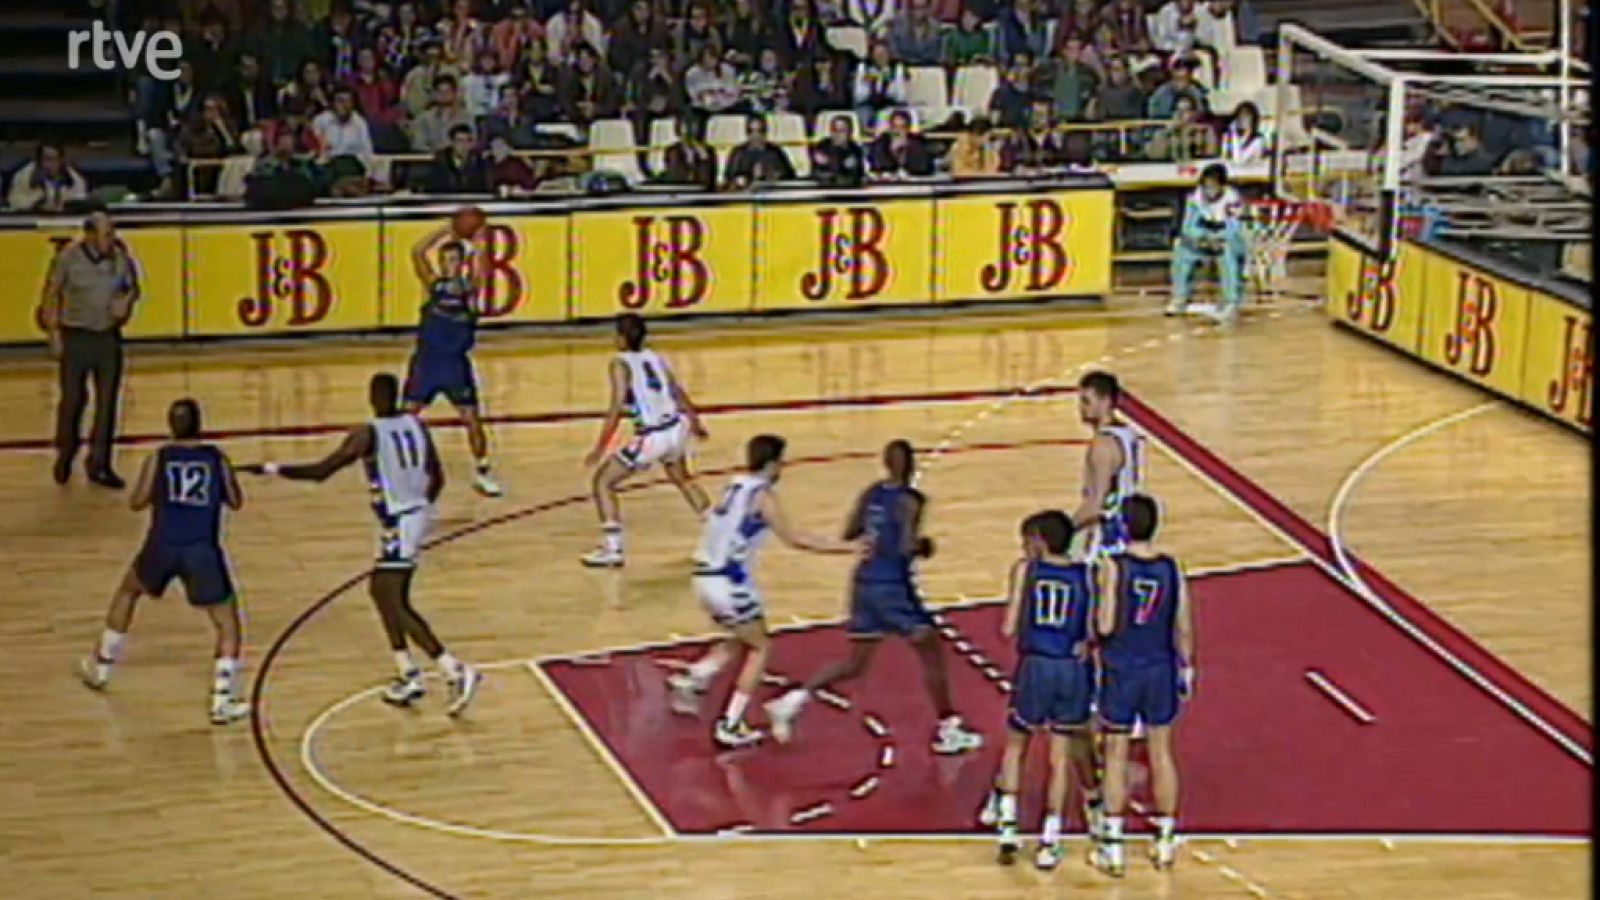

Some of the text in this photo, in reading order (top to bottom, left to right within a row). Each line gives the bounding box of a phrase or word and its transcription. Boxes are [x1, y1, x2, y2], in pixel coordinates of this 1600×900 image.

[238, 229, 332, 327] J&B
[618, 215, 709, 309] J&B
[801, 206, 889, 300] J&B
[987, 198, 1068, 292] J&B
[1445, 270, 1496, 377] J&B
[642, 360, 662, 393] 4
[165, 461, 210, 506] 12
[390, 430, 418, 470] 11
[1133, 578, 1165, 625] 7
